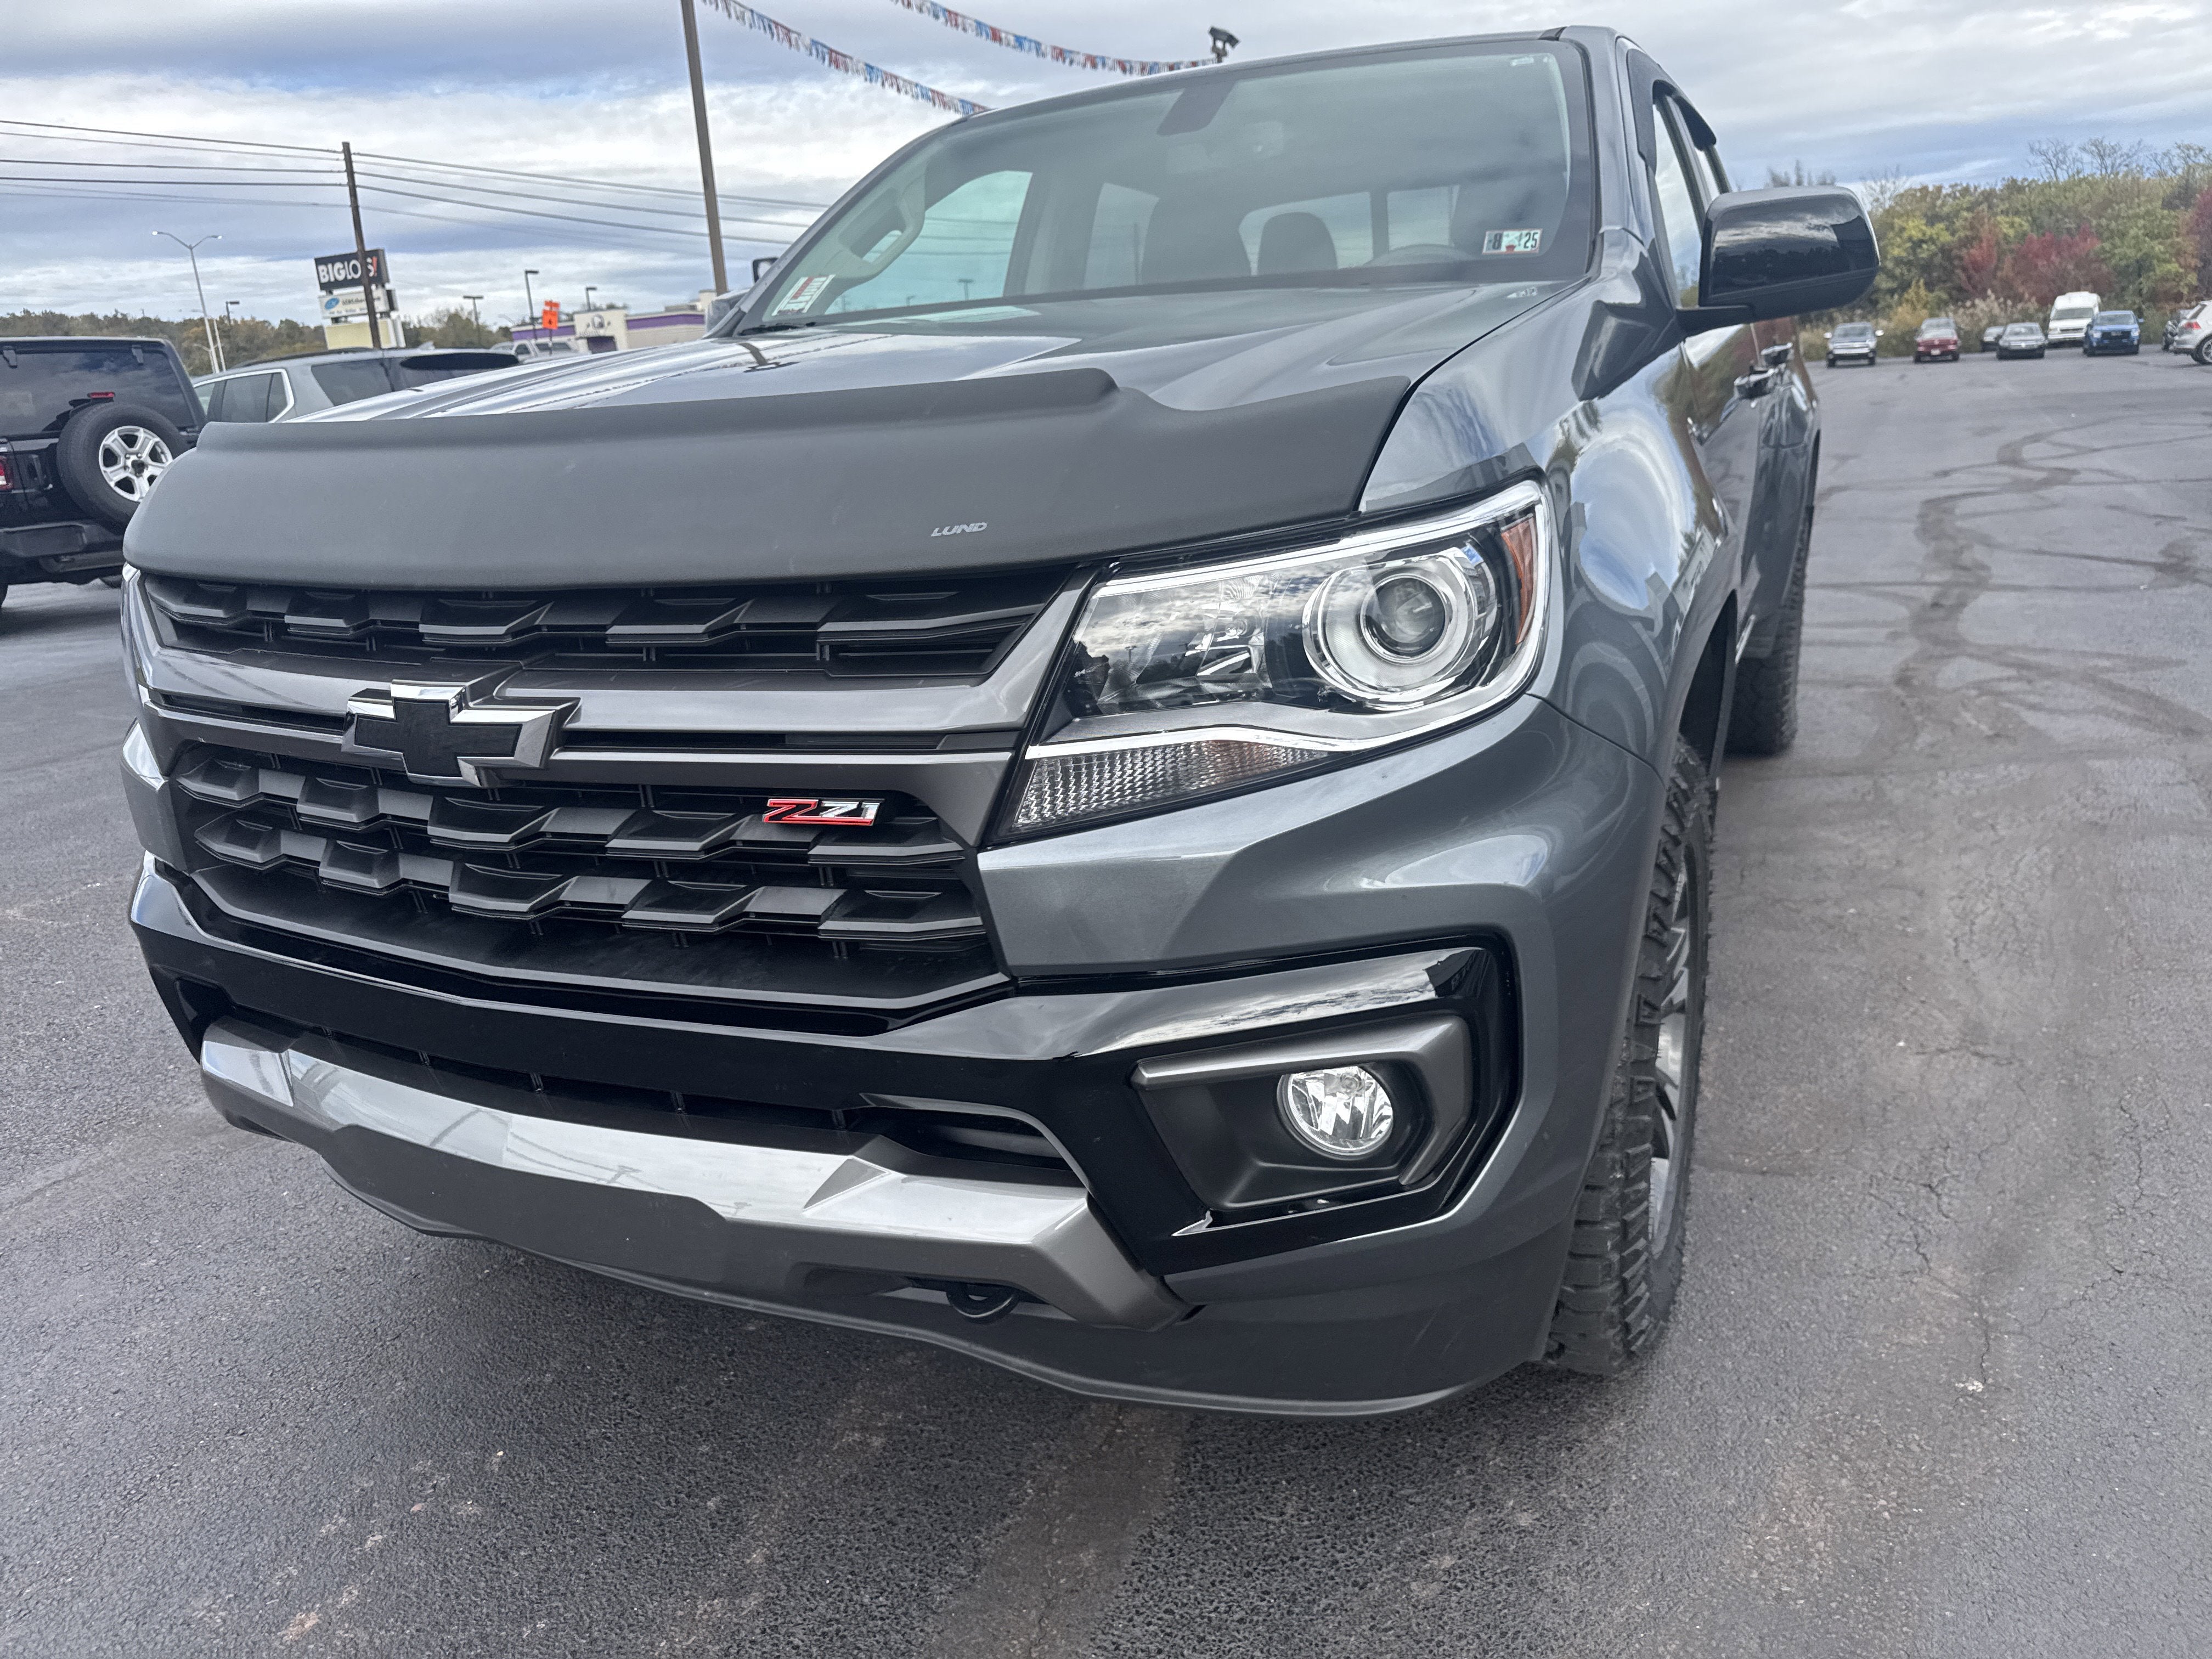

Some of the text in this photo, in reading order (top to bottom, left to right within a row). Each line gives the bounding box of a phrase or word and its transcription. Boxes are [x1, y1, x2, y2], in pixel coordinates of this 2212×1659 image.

[1492, 232, 1538, 250] 8 25
[931, 522, 988, 537] LUND
[763, 798, 880, 826] Z71
